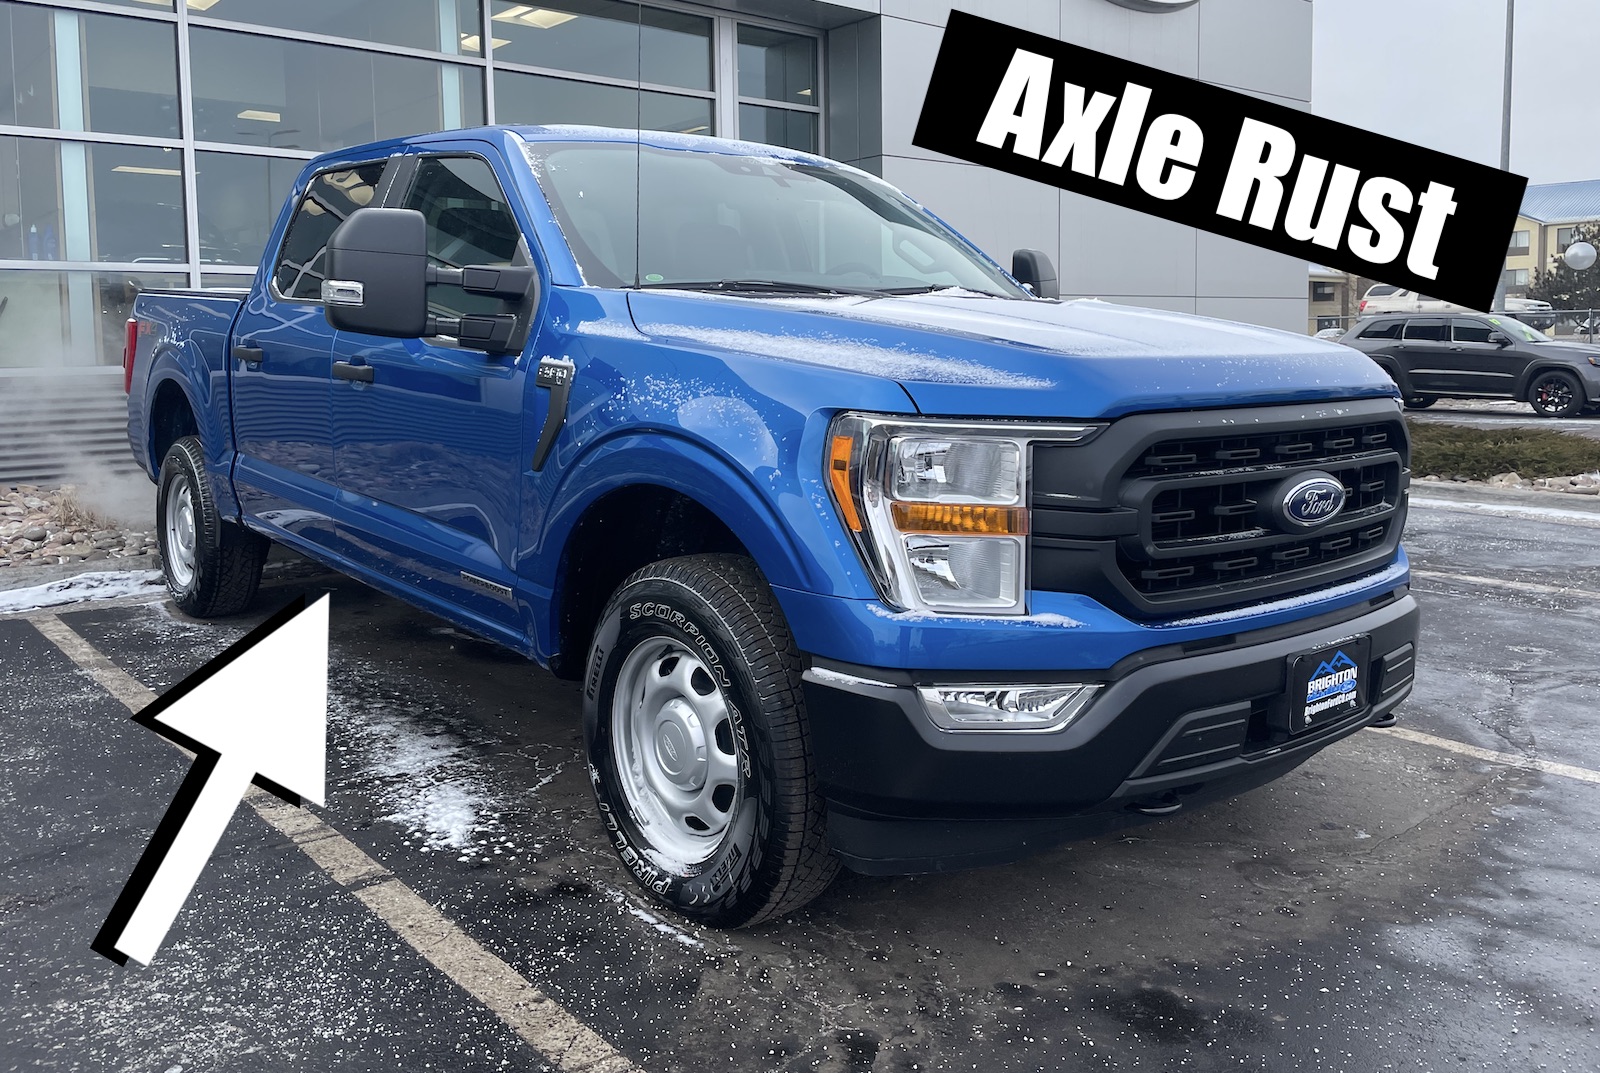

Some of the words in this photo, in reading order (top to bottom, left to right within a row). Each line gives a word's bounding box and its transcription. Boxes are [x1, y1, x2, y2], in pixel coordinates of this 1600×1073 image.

[1301, 489, 1335, 516] Ford
[586, 643, 605, 702] PIRELLI
[629, 602, 732, 687] SCORPION
[727, 699, 751, 779] ATR
[1307, 666, 1358, 694] BRIGHTON
[598, 801, 672, 895] PIRELLI
